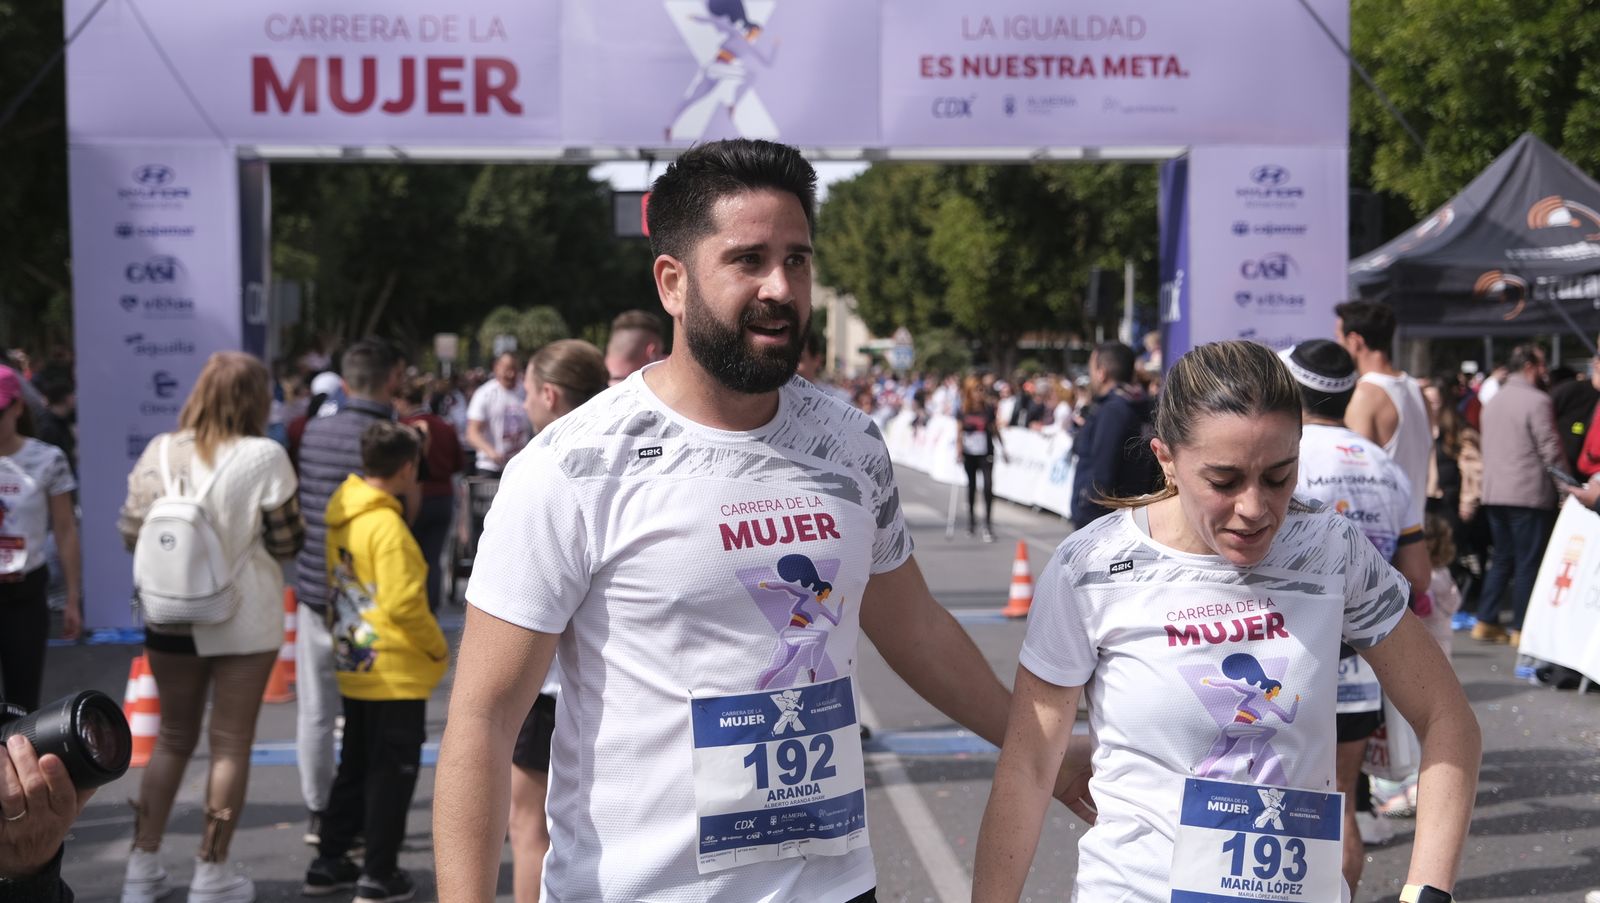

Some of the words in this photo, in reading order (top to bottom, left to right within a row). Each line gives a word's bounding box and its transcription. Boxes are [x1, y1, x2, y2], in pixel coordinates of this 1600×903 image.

[264, 13, 409, 42] CARRERA
[419, 14, 455, 42] DE
[469, 14, 506, 42] LA
[962, 15, 997, 40] LA
[1004, 15, 1147, 41] IGUALDAD
[919, 55, 954, 78] ES
[961, 55, 1096, 78] NUESTRA
[1103, 55, 1190, 78] META.
[250, 55, 523, 116] MUJER
[640, 447, 661, 458] 42K
[720, 500, 784, 517] CARRERA
[785, 497, 802, 510] DE
[807, 496, 824, 507] LA
[719, 512, 841, 551] MUJER
[1111, 562, 1133, 573] 42K
[1166, 603, 1233, 622] CARRERA
[1236, 600, 1256, 613] DE
[1258, 597, 1276, 610] LA
[1164, 612, 1290, 647] MUJER
[719, 714, 766, 728] MUJER
[744, 733, 837, 790] 192
[767, 782, 821, 801] ARANDA
[1211, 795, 1233, 803] CARRERA
[764, 800, 789, 808] ALBERTO
[790, 797, 811, 805] ARANDA
[1207, 800, 1249, 815] MUJER
[734, 817, 757, 831] CDX
[1222, 832, 1307, 882] 193
[1221, 877, 1263, 892] MARÍA
[1267, 880, 1303, 895] LÓPEZ
